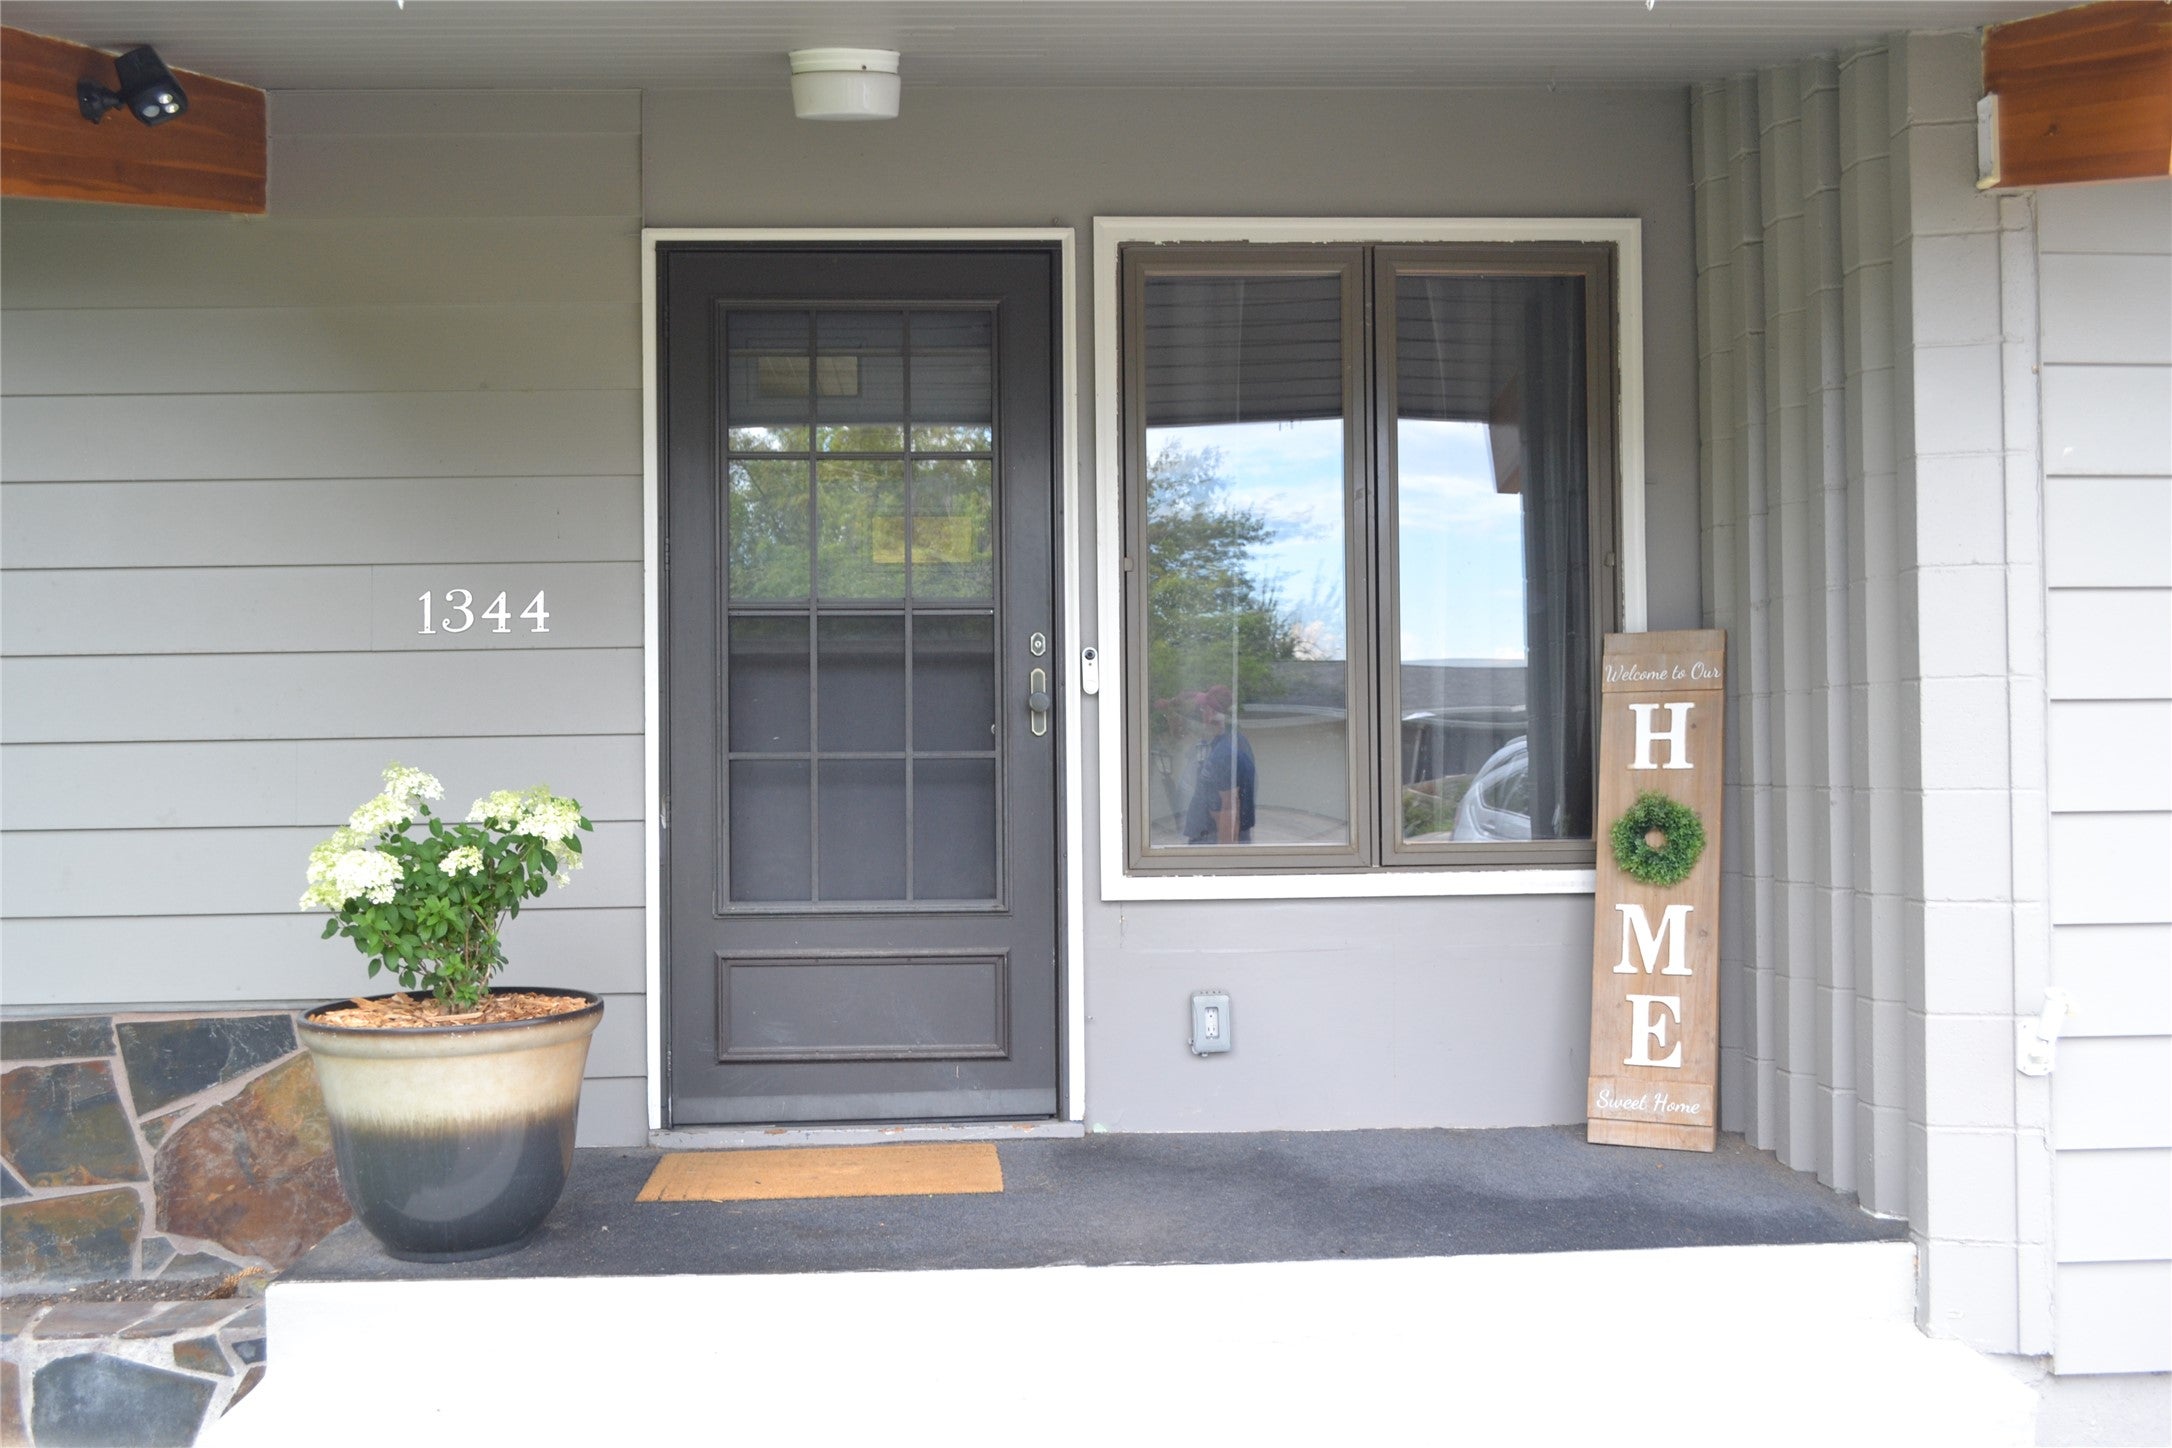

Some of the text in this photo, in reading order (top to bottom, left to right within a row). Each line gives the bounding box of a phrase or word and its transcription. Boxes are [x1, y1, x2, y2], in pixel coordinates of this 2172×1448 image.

[417, 588, 550, 634] 1344
[1605, 661, 1721, 683] Welcome to Our
[1596, 1089, 1701, 1114] Sweet Home
